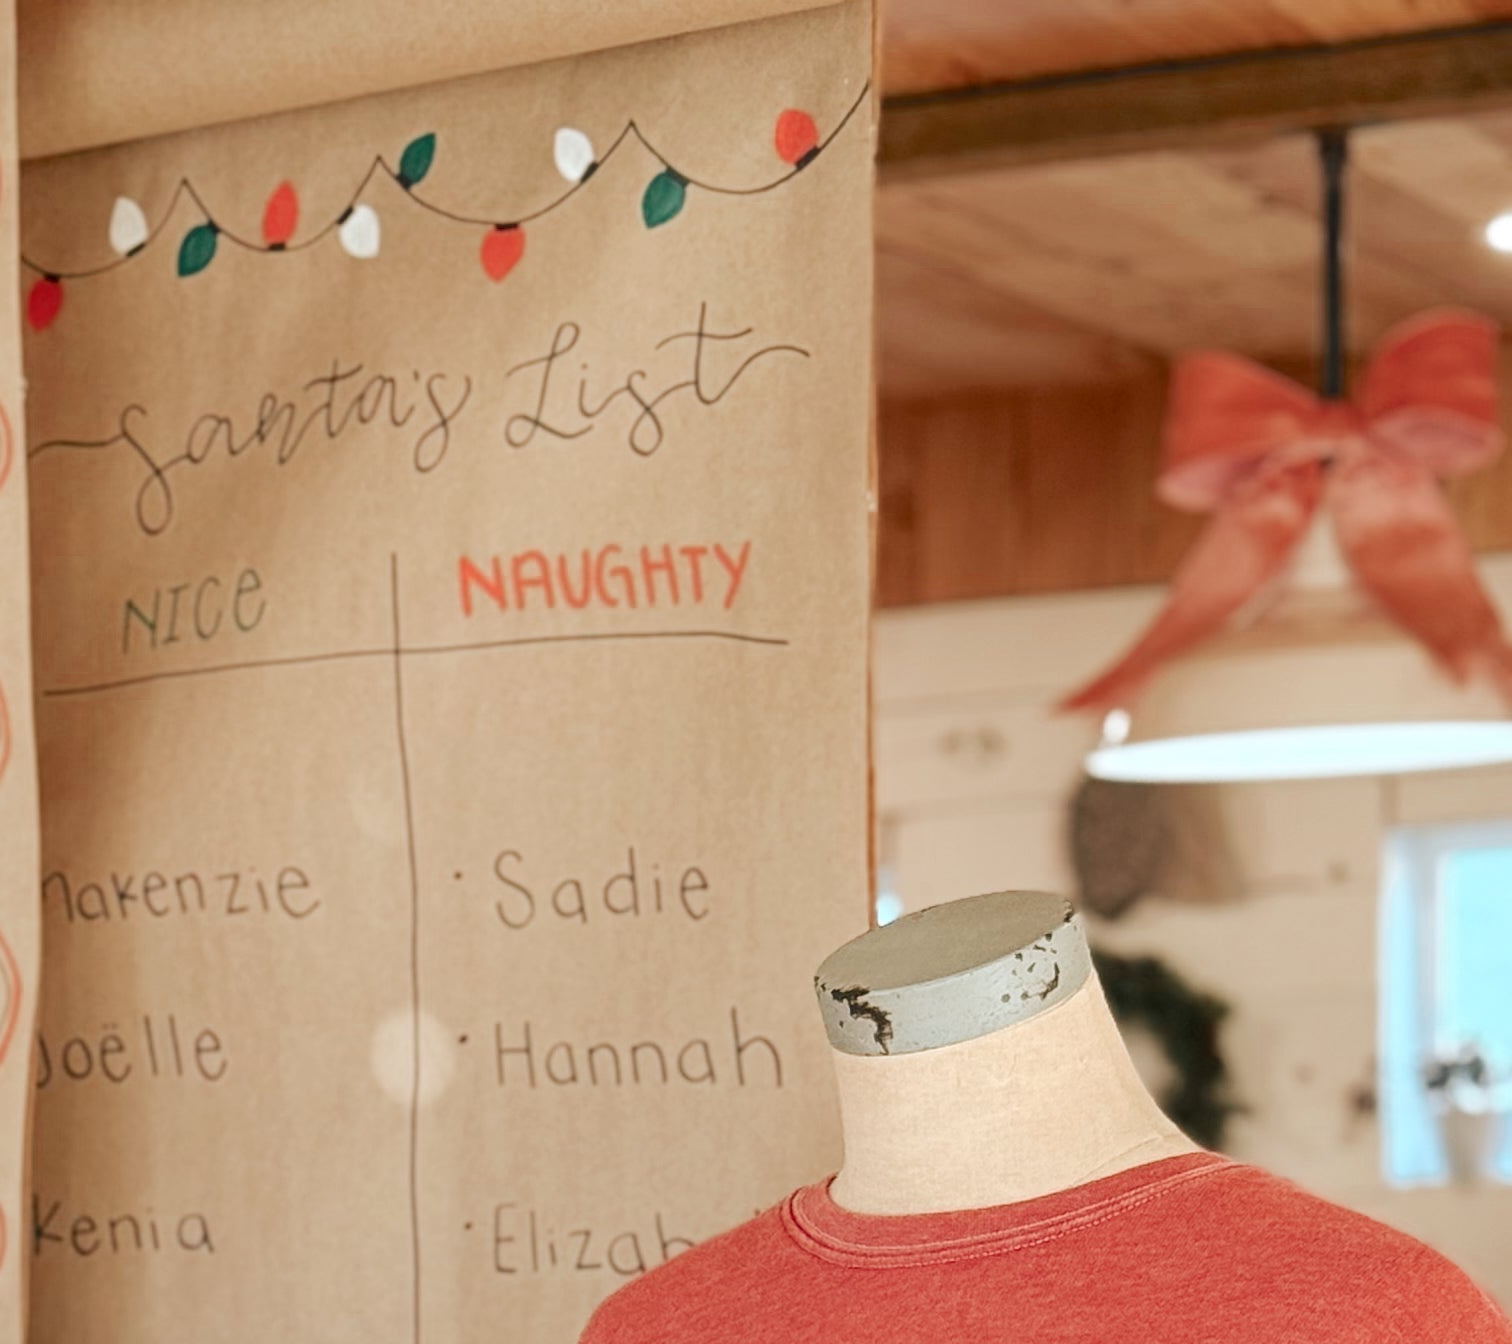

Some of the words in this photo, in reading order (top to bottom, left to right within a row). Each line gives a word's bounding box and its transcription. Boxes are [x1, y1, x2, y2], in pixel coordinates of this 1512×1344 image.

[29, 358, 472, 535] Santa's
[504, 301, 811, 457] List
[458, 541, 753, 618] NAUGHTY
[493, 846, 712, 930] Sadie
[35, 1014, 229, 1090] Joëlle
[494, 1006, 784, 1089] Hannah
